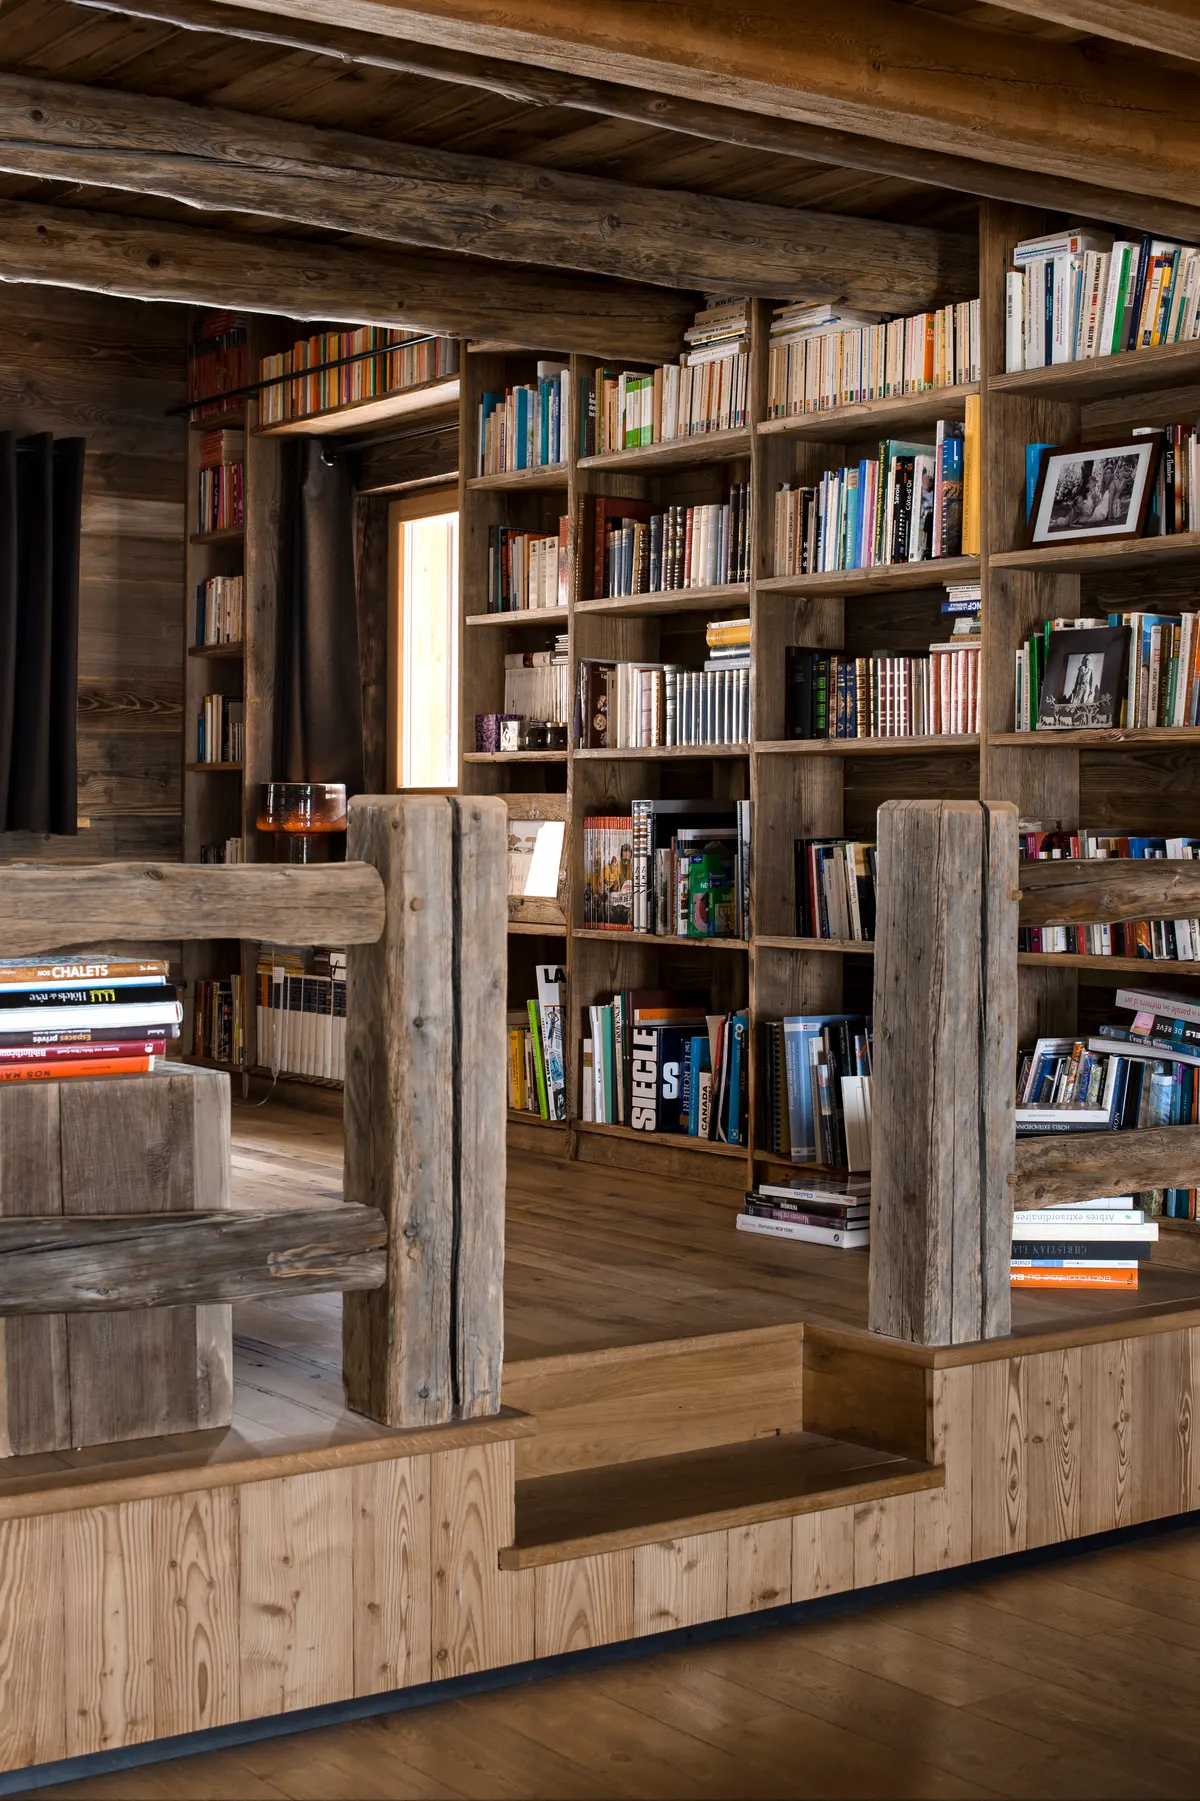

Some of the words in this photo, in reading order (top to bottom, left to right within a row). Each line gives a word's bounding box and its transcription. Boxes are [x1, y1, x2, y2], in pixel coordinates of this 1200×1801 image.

[52, 965, 108, 978] CHALETS
[544, 968, 566, 984] LA
[29, 993, 48, 1002] rêve
[58, 992, 86, 1001] Hôtels
[90, 993, 115, 1002] ELLE
[1140, 999, 1162, 1011] métiers
[1171, 1005, 1191, 1018] parole
[1156, 1023, 1173, 1034] RÊVE
[32, 1035, 58, 1043] privés
[26, 1070, 50, 1078] NOS
[545, 1076, 551, 1087] LA
[631, 1028, 658, 1132] SIECLE
[1016, 1214, 1083, 1222] extraordinaires
[1086, 1214, 1115, 1222] Arbres
[1033, 1245, 1087, 1254] CHRISTIAN
